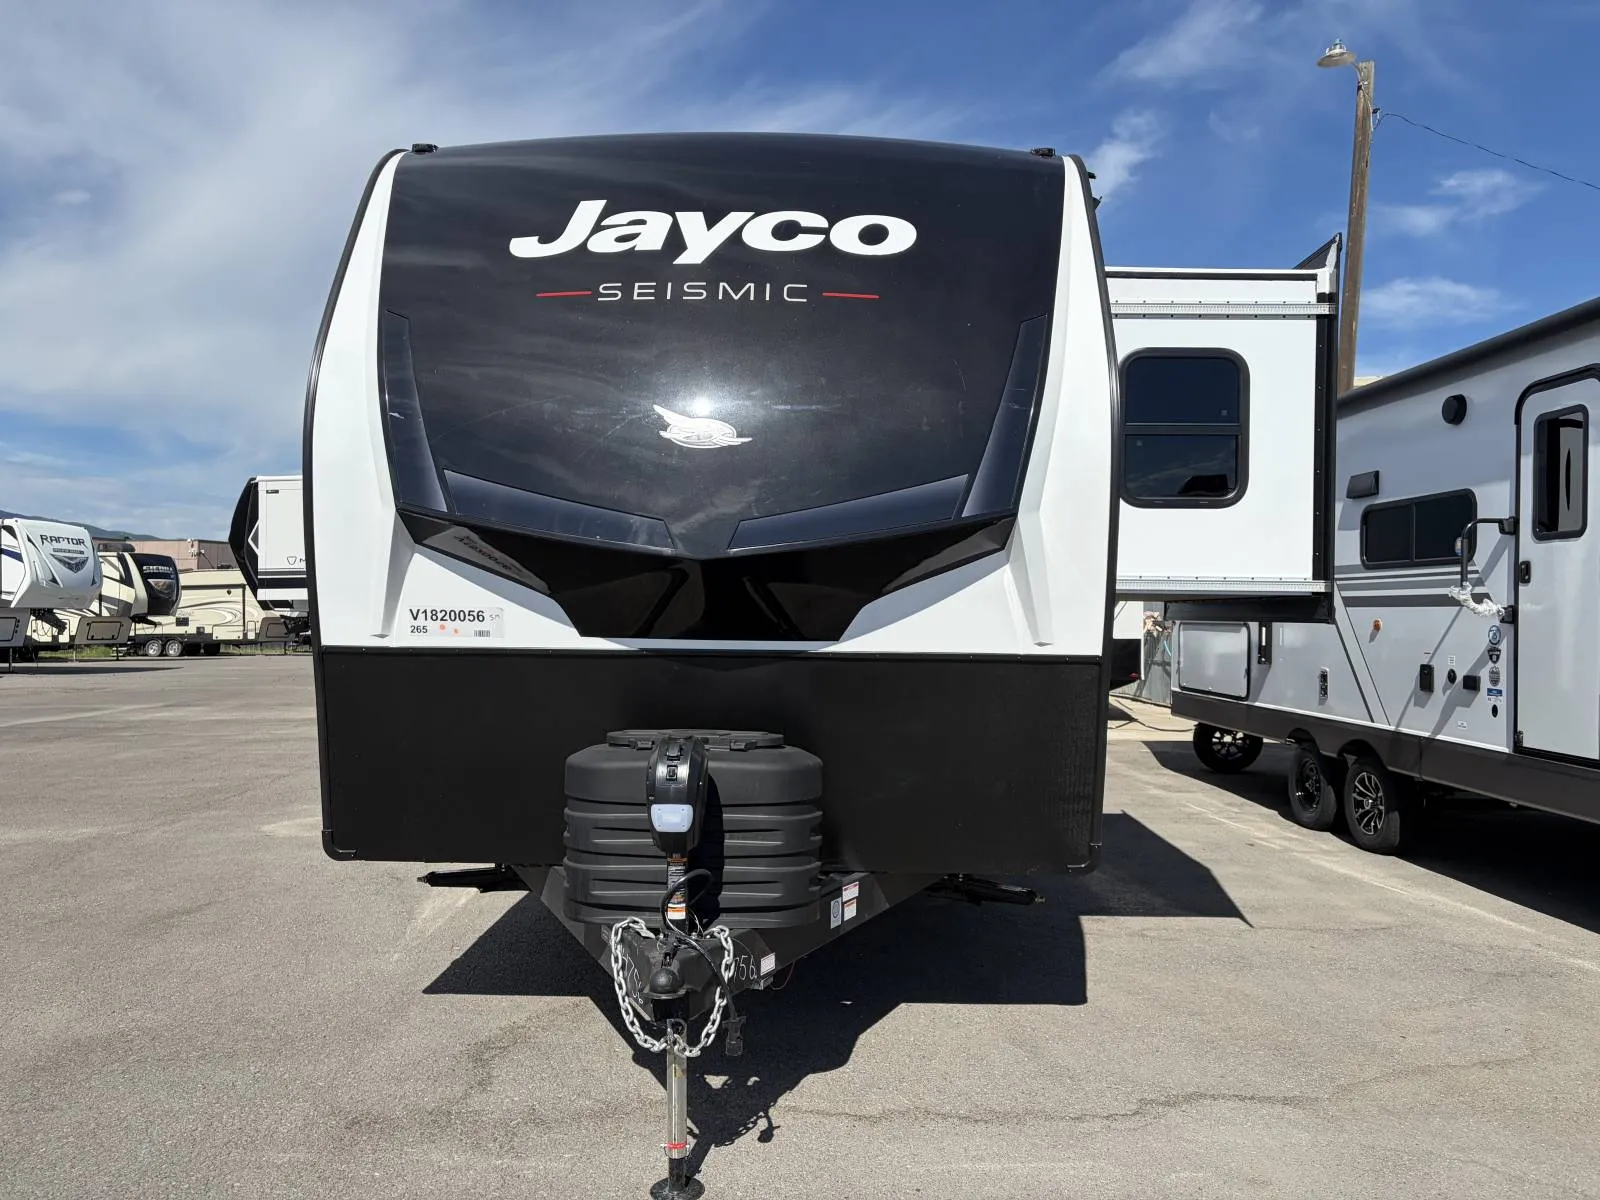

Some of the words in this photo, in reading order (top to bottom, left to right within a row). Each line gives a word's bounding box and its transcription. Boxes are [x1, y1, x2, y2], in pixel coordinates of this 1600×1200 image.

[509, 200, 917, 265] Jayco
[597, 281, 808, 302] SEISMIC
[40, 534, 88, 549] RAPTOR
[409, 608, 486, 623] V1820056
[410, 625, 428, 634] 265
